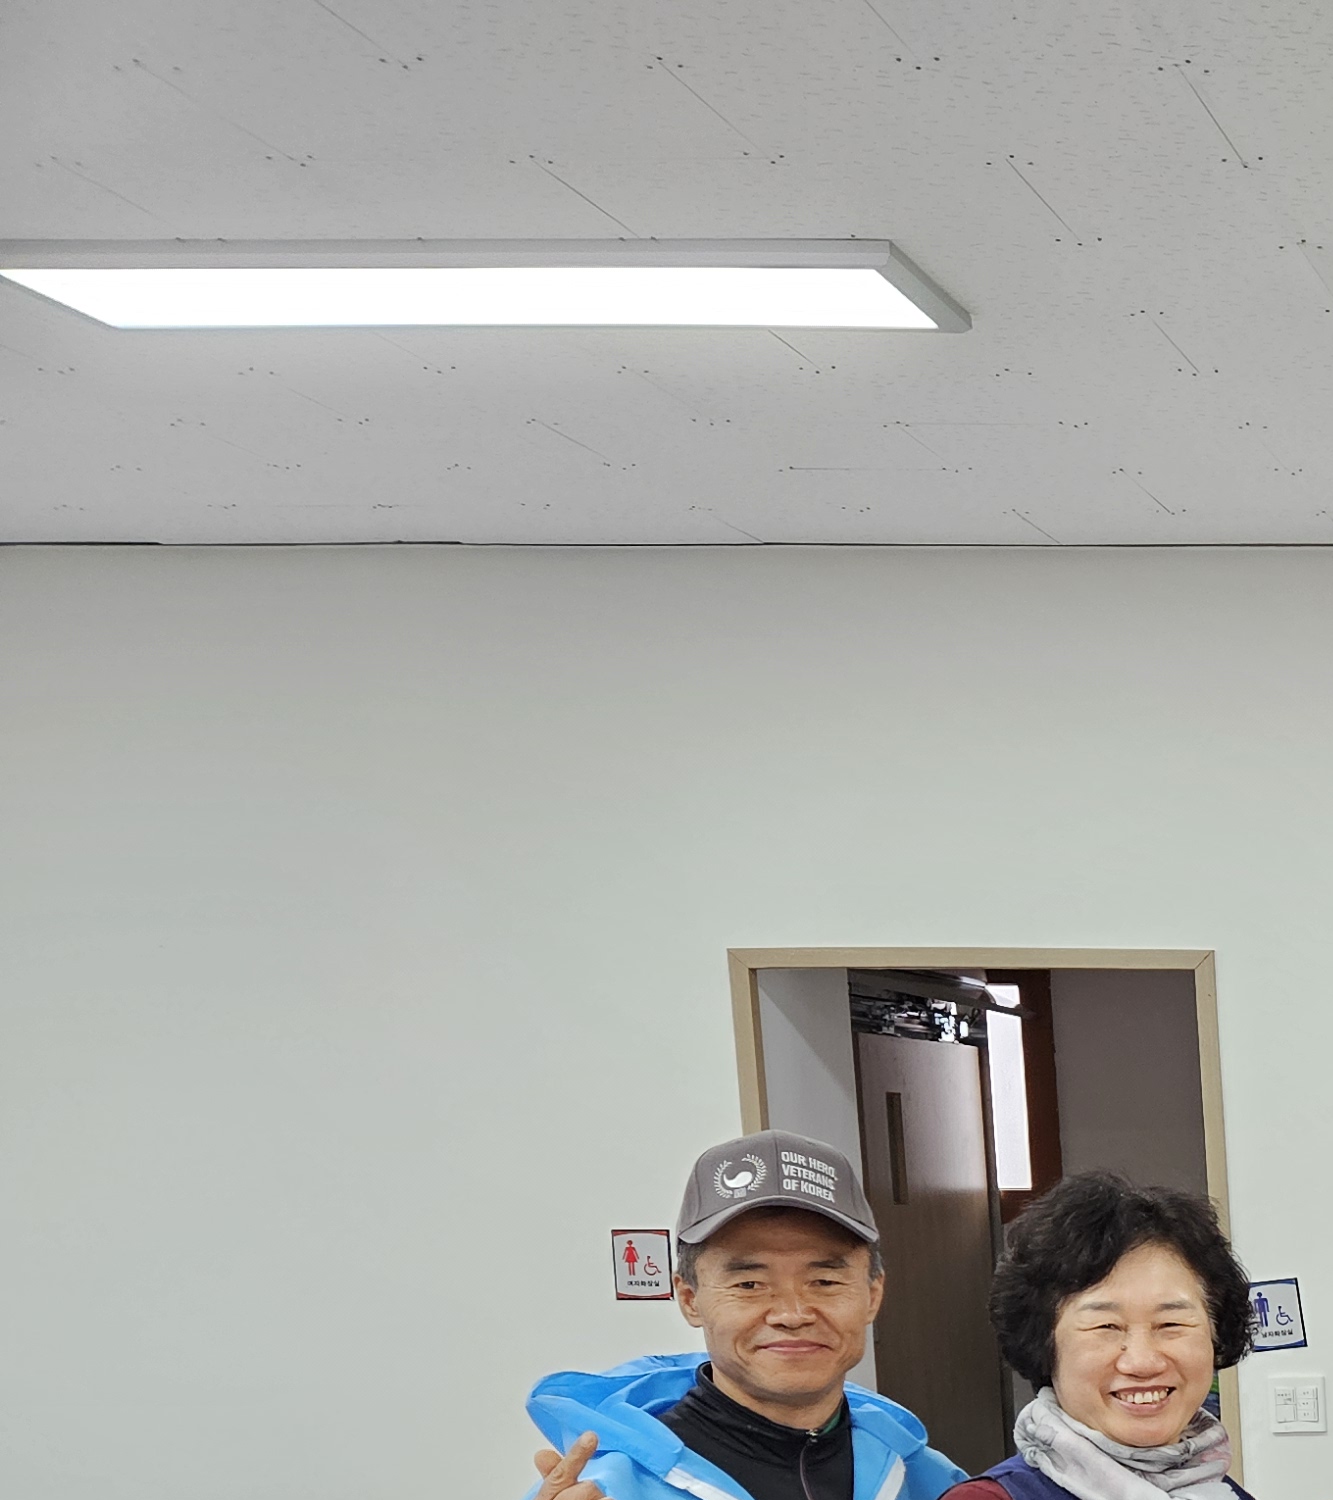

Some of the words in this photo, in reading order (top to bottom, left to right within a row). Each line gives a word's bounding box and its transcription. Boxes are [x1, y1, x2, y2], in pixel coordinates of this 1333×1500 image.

[781, 1151, 807, 1167] OUR
[781, 1163, 836, 1190] VETERANS
[783, 1178, 800, 1191] OF
[800, 1180, 836, 1203] KOREA
